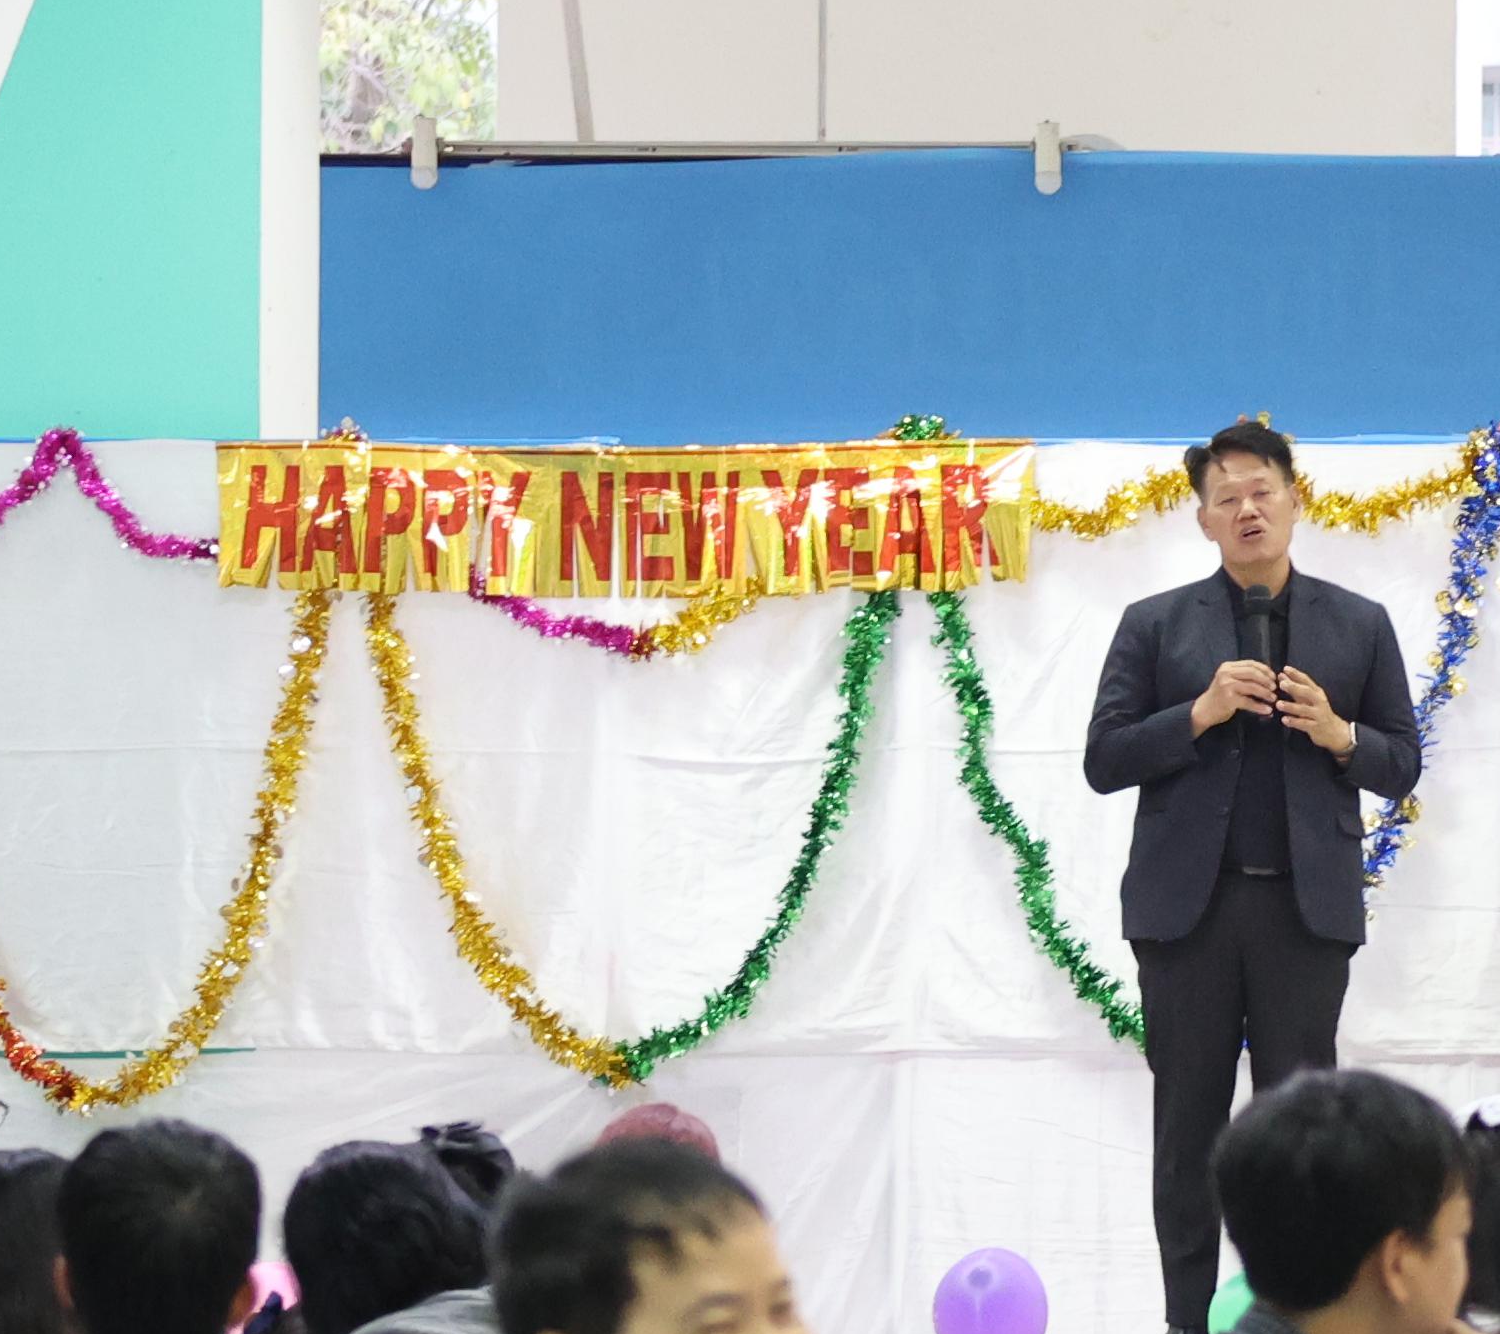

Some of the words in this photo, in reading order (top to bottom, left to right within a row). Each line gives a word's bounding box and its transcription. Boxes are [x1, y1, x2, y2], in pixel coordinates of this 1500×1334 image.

[240, 464, 531, 577] HAPPY
[560, 471, 740, 581] NEW
[761, 465, 1000, 577] YEAR
